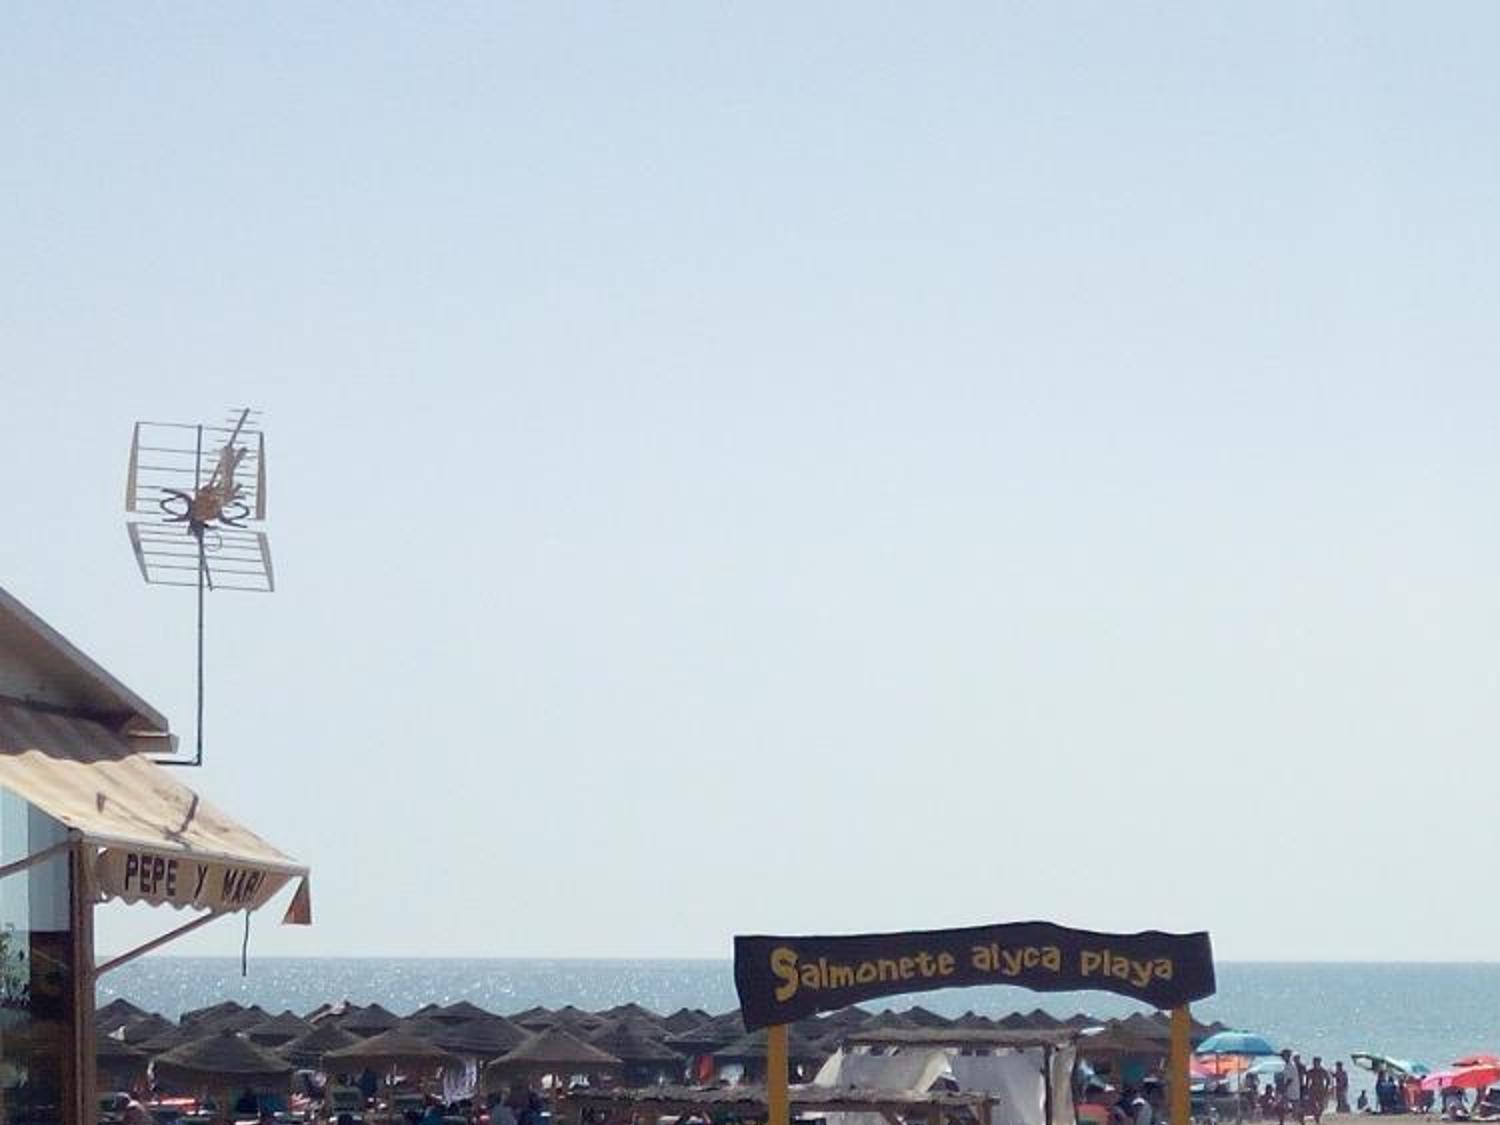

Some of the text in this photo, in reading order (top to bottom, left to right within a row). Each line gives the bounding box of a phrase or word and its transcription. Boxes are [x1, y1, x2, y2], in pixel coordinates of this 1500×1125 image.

[124, 853, 178, 897] PEPE
[193, 863, 209, 900] Y
[769, 946, 957, 1002] Salmonete
